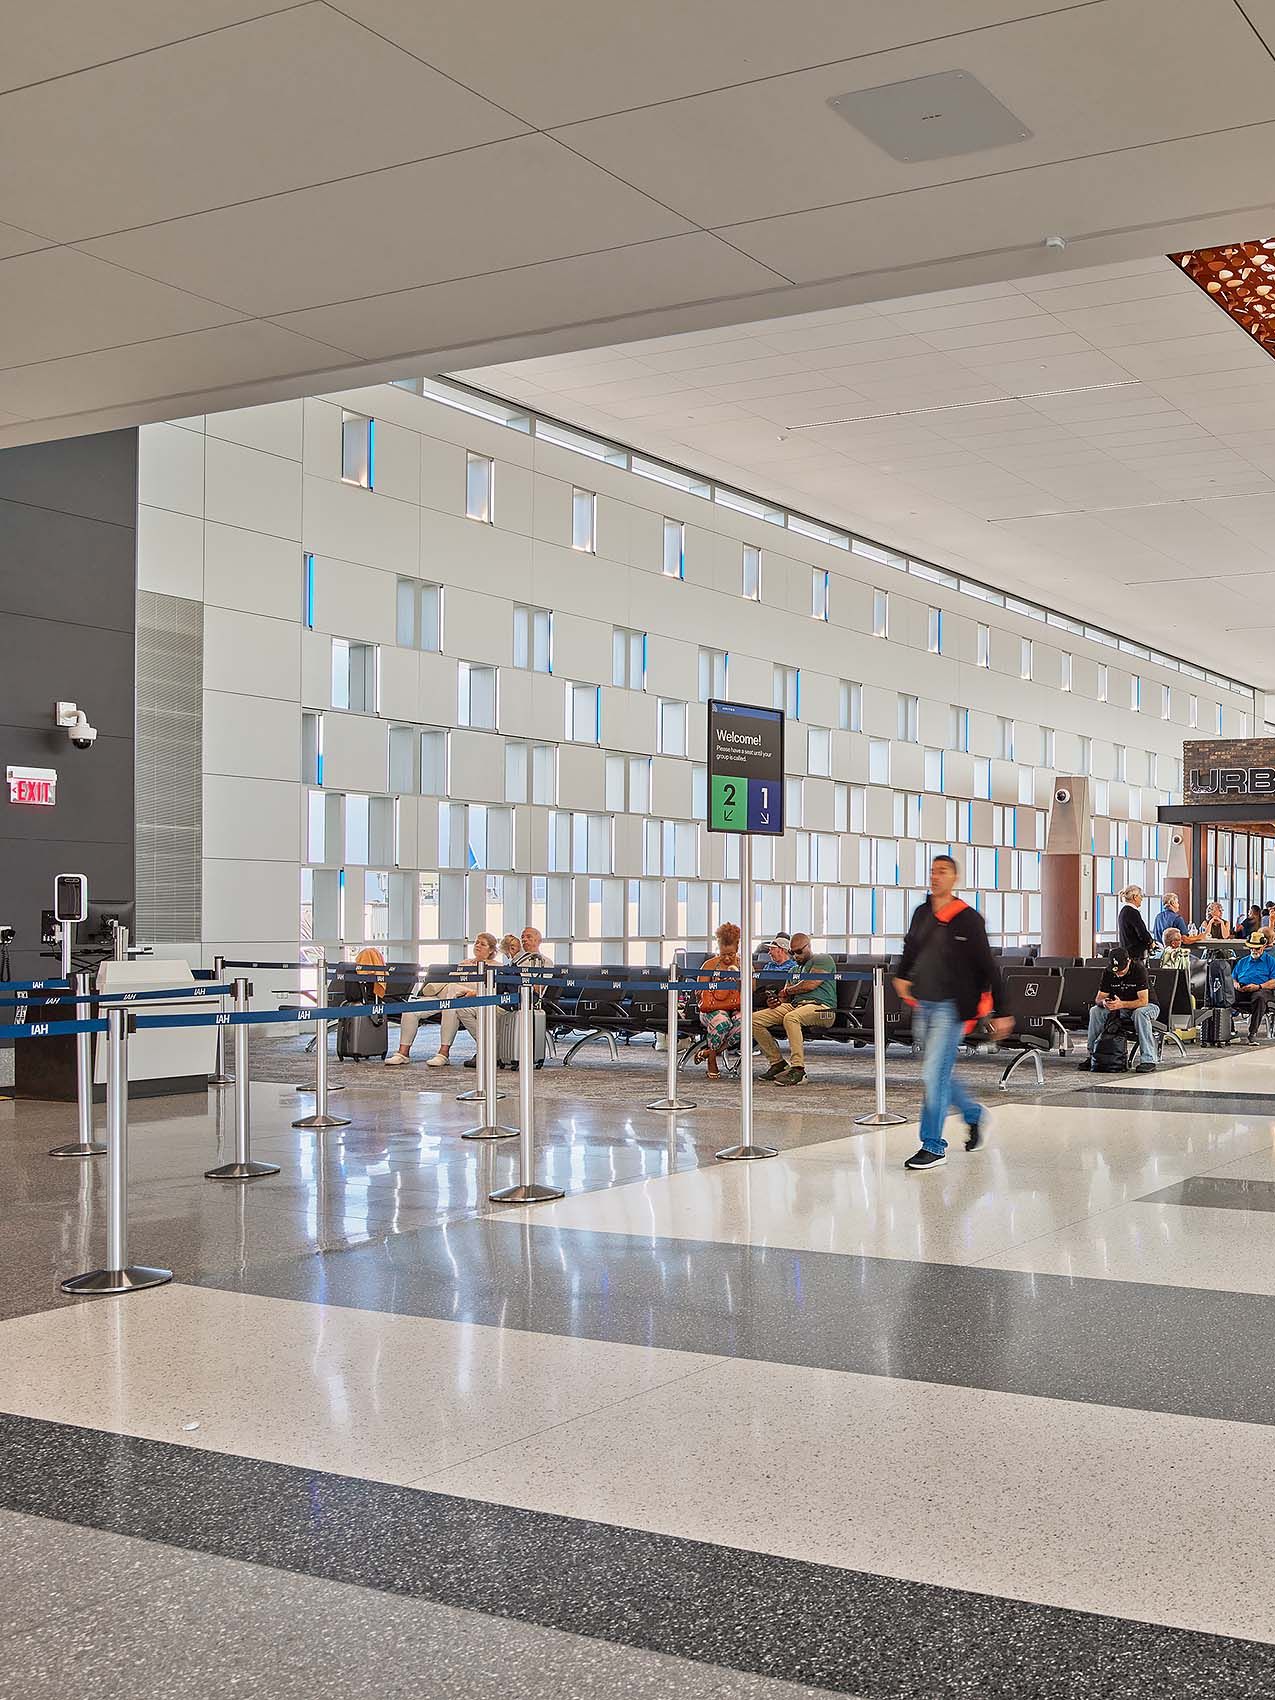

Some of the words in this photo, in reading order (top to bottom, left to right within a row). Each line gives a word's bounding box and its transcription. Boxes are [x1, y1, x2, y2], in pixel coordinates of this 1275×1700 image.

[716, 729, 762, 746] Welcome!
[716, 744, 731, 753] Please
[17, 780, 51, 803] EXIT
[723, 783, 736, 806] 2
[761, 787, 769, 809] 1
[32, 981, 44, 989] IAH
[194, 988, 206, 996] IAH
[501, 994, 511, 1004] IAH
[440, 1000, 450, 1009] IAH
[297, 1010, 311, 1020] IAH
[372, 1005, 384, 1015] IAH
[216, 1014, 231, 1024] IAH
[31, 1023, 49, 1036] IAH
